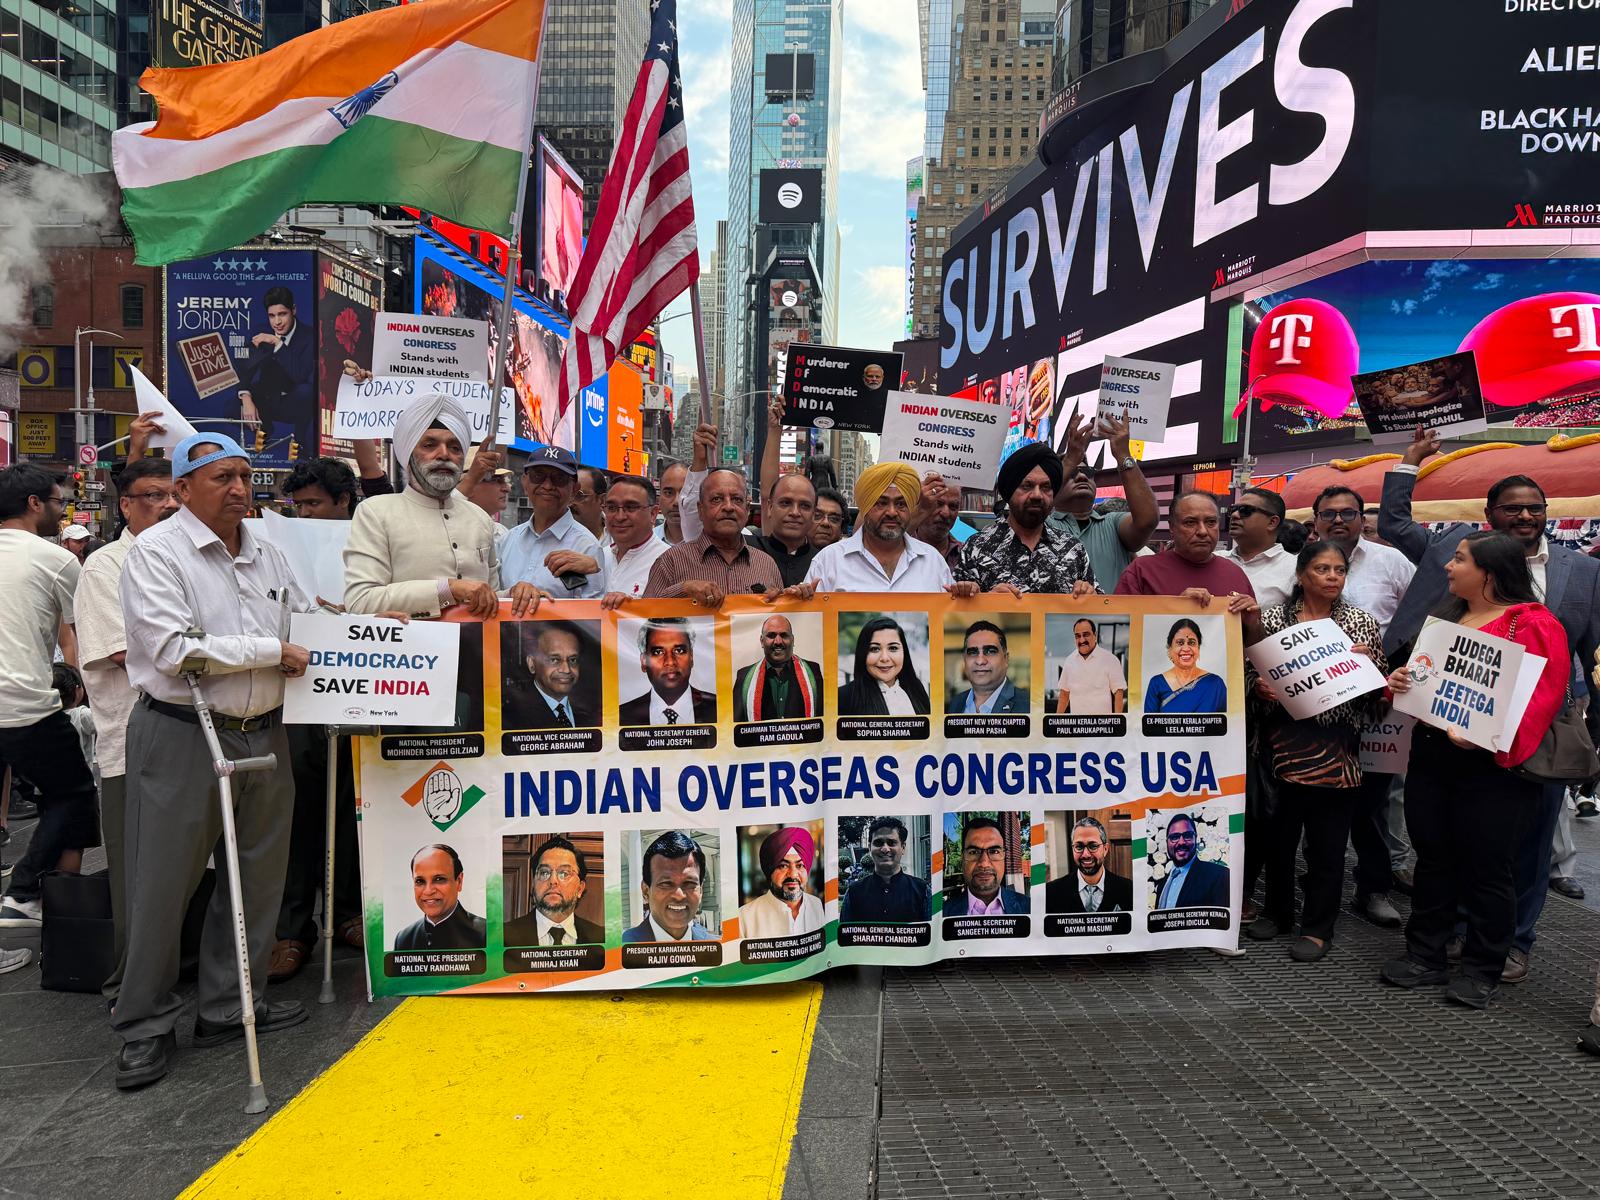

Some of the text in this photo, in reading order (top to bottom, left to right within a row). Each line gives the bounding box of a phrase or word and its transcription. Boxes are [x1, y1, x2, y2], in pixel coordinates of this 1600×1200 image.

[163, 0, 195, 34] THE
[224, 14, 262, 39] ON BROADWAY
[1048, 81, 1081, 112] MARRIOTT
[1048, 96, 1076, 123] MARQUIS
[1480, 107, 1568, 130] BLACK
[940, 0, 1356, 368] SURVIVES
[1228, 256, 1256, 272] MARRIOTT
[1227, 266, 1252, 282] MARQUIS
[323, 272, 378, 311] WORLD COULD BE
[177, 297, 252, 308] JEREMY
[177, 310, 250, 330] JORDAN
[387, 323, 474, 337] INDIAN OVERSEAS
[189, 342, 214, 362] JUST
[404, 339, 456, 350] CONGRESS
[192, 354, 229, 375] TIME
[401, 353, 458, 364] Stands with
[796, 355, 850, 370] Murderer
[390, 365, 469, 379] INDIAN students
[1111, 367, 1160, 380] OVERSEAS
[354, 380, 415, 397] TODAY'S
[793, 381, 857, 397] Democratic
[586, 387, 604, 412] prime
[793, 397, 834, 411] INDIA
[1118, 400, 1139, 409] with
[901, 404, 997, 424] INDIAN OVERSEAS
[1379, 402, 1462, 422] PM should apologize
[1431, 413, 1464, 426] RAHUL
[918, 422, 975, 438] CONGRESS
[913, 438, 974, 454] Stands with
[899, 451, 982, 470] INDIAN students
[1193, 462, 1216, 471] SEPHORA
[348, 625, 403, 642] SAVE
[1281, 627, 1318, 650] SAVE
[309, 651, 438, 669] DEMOCRACY
[1449, 635, 1502, 669] JUDEGA
[1269, 642, 1347, 681] DEMOCRACY
[1285, 659, 1361, 697] SAVE INDIA
[1444, 655, 1500, 689] BHARAT
[312, 678, 430, 696] SAVE INDIA
[1435, 679, 1494, 716] JEETEGA
[1430, 697, 1470, 729] INDIA
[740, 726, 767, 734] CHAIRMAN
[769, 724, 800, 732] TELANGANA
[776, 733, 804, 741] GADULA
[430, 738, 465, 746] PRESIDENT
[520, 742, 584, 751] GEORGE ABRAHAM
[666, 738, 692, 746] JOSEPH
[450, 747, 478, 755] GILZIAN
[504, 750, 1217, 818] INDIAN OVERSEAS CONGRESS USA
[853, 935, 917, 943] SHARATH CHANDRA
[957, 928, 989, 936] SANGEETH
[395, 955, 426, 963] NATIONAL
[442, 954, 476, 962] PRESIDENT
[531, 960, 558, 968] MINHAJ
[648, 955, 696, 964] RAJIV GOWDA
[401, 964, 470, 973] BALDEV RANDHAWA
